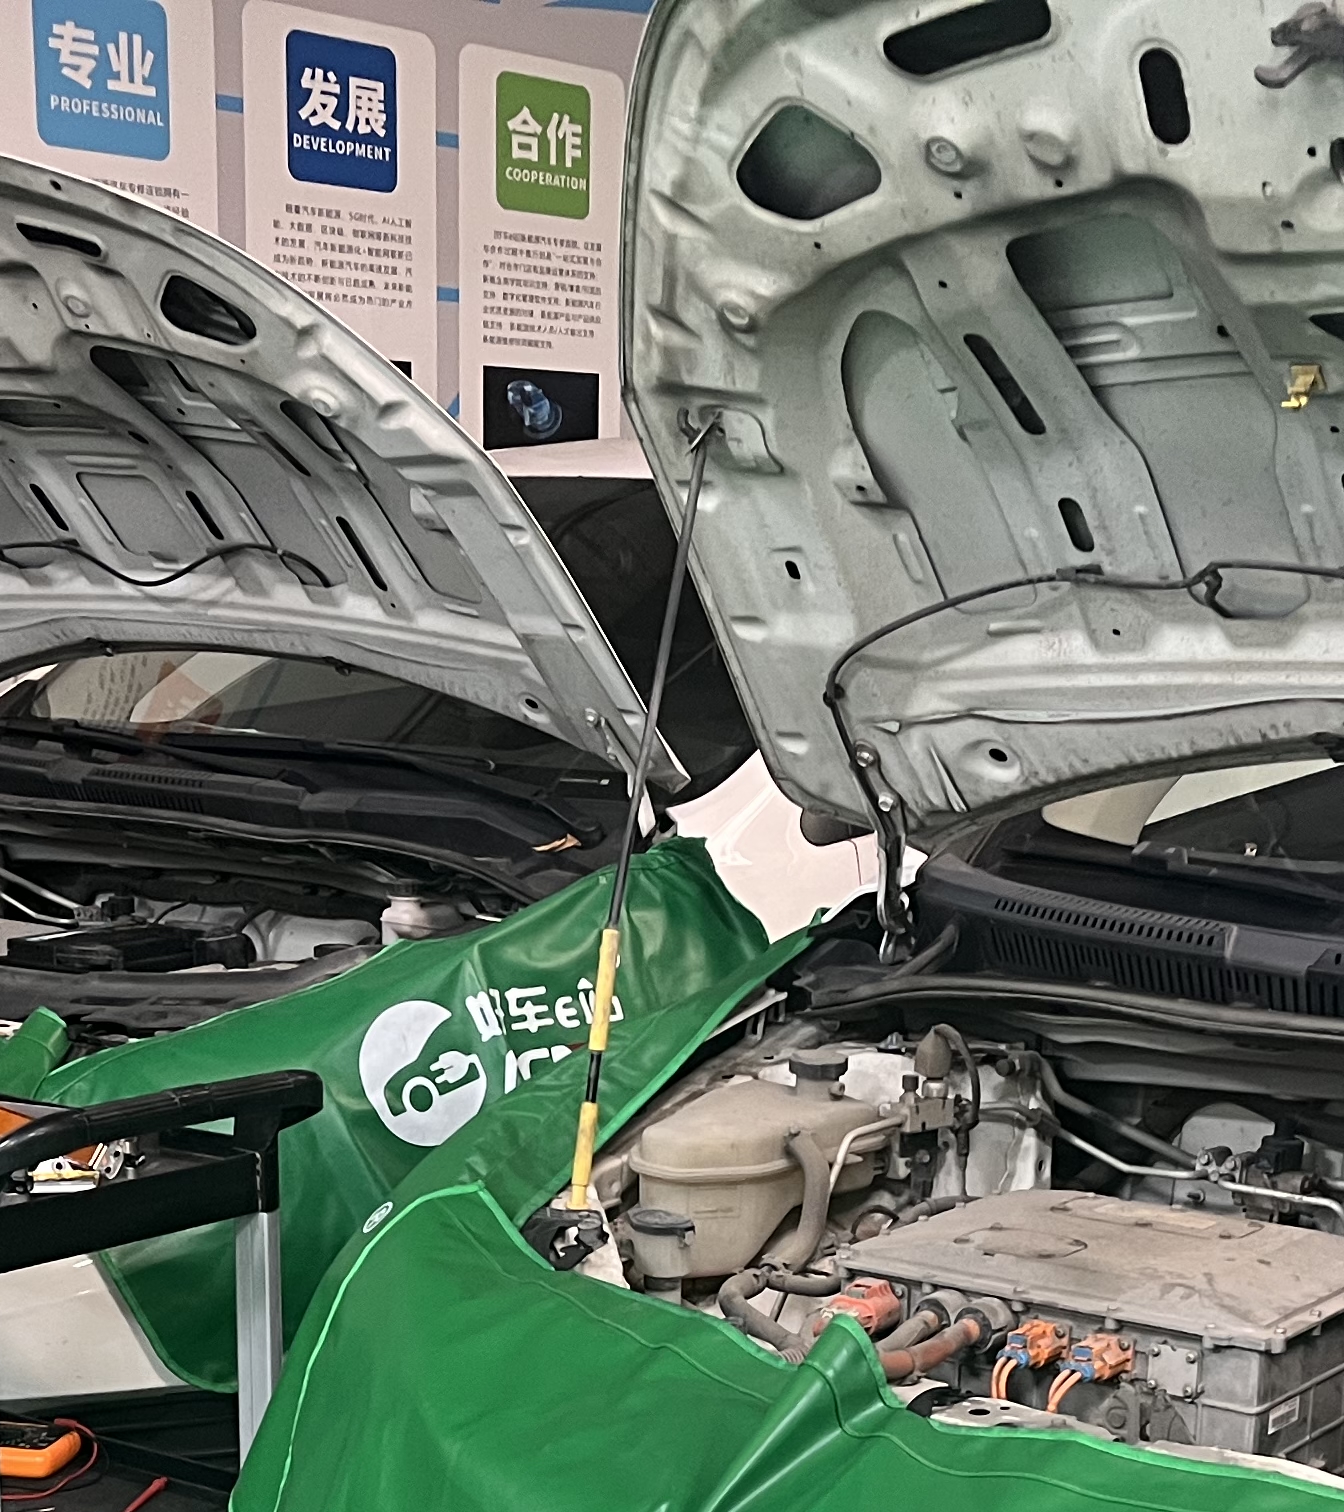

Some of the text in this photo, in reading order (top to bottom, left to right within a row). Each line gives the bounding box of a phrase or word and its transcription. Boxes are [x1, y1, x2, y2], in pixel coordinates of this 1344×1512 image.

[48, 20, 157, 97] 专业
[49, 94, 164, 128] PROFESSIONAL
[298, 66, 387, 138] 发展
[292, 132, 392, 162] DEVELOPMENT
[507, 105, 583, 168] 合作
[505, 166, 588, 191] COOPERATION
